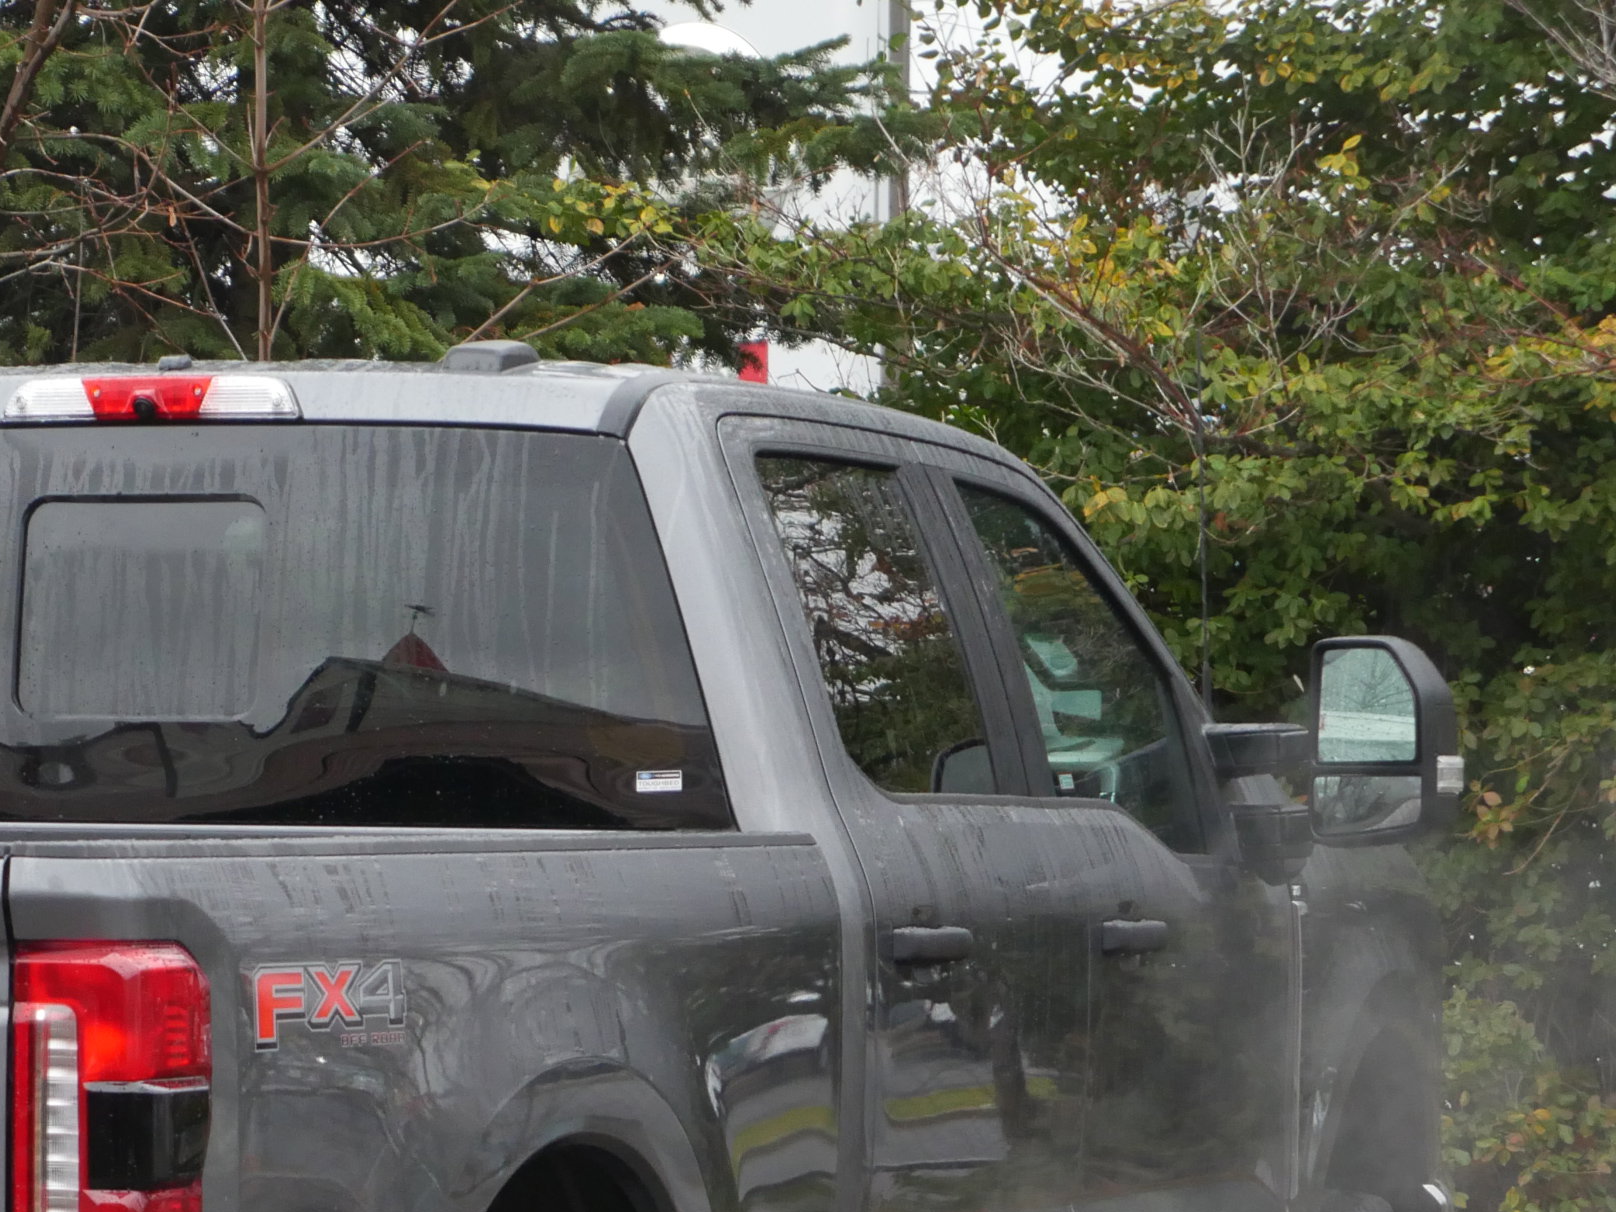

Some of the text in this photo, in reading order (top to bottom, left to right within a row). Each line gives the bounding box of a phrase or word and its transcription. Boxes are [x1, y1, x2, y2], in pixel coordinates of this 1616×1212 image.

[253, 958, 407, 1053] FX4
[340, 1031, 407, 1048] OFF ROAD
